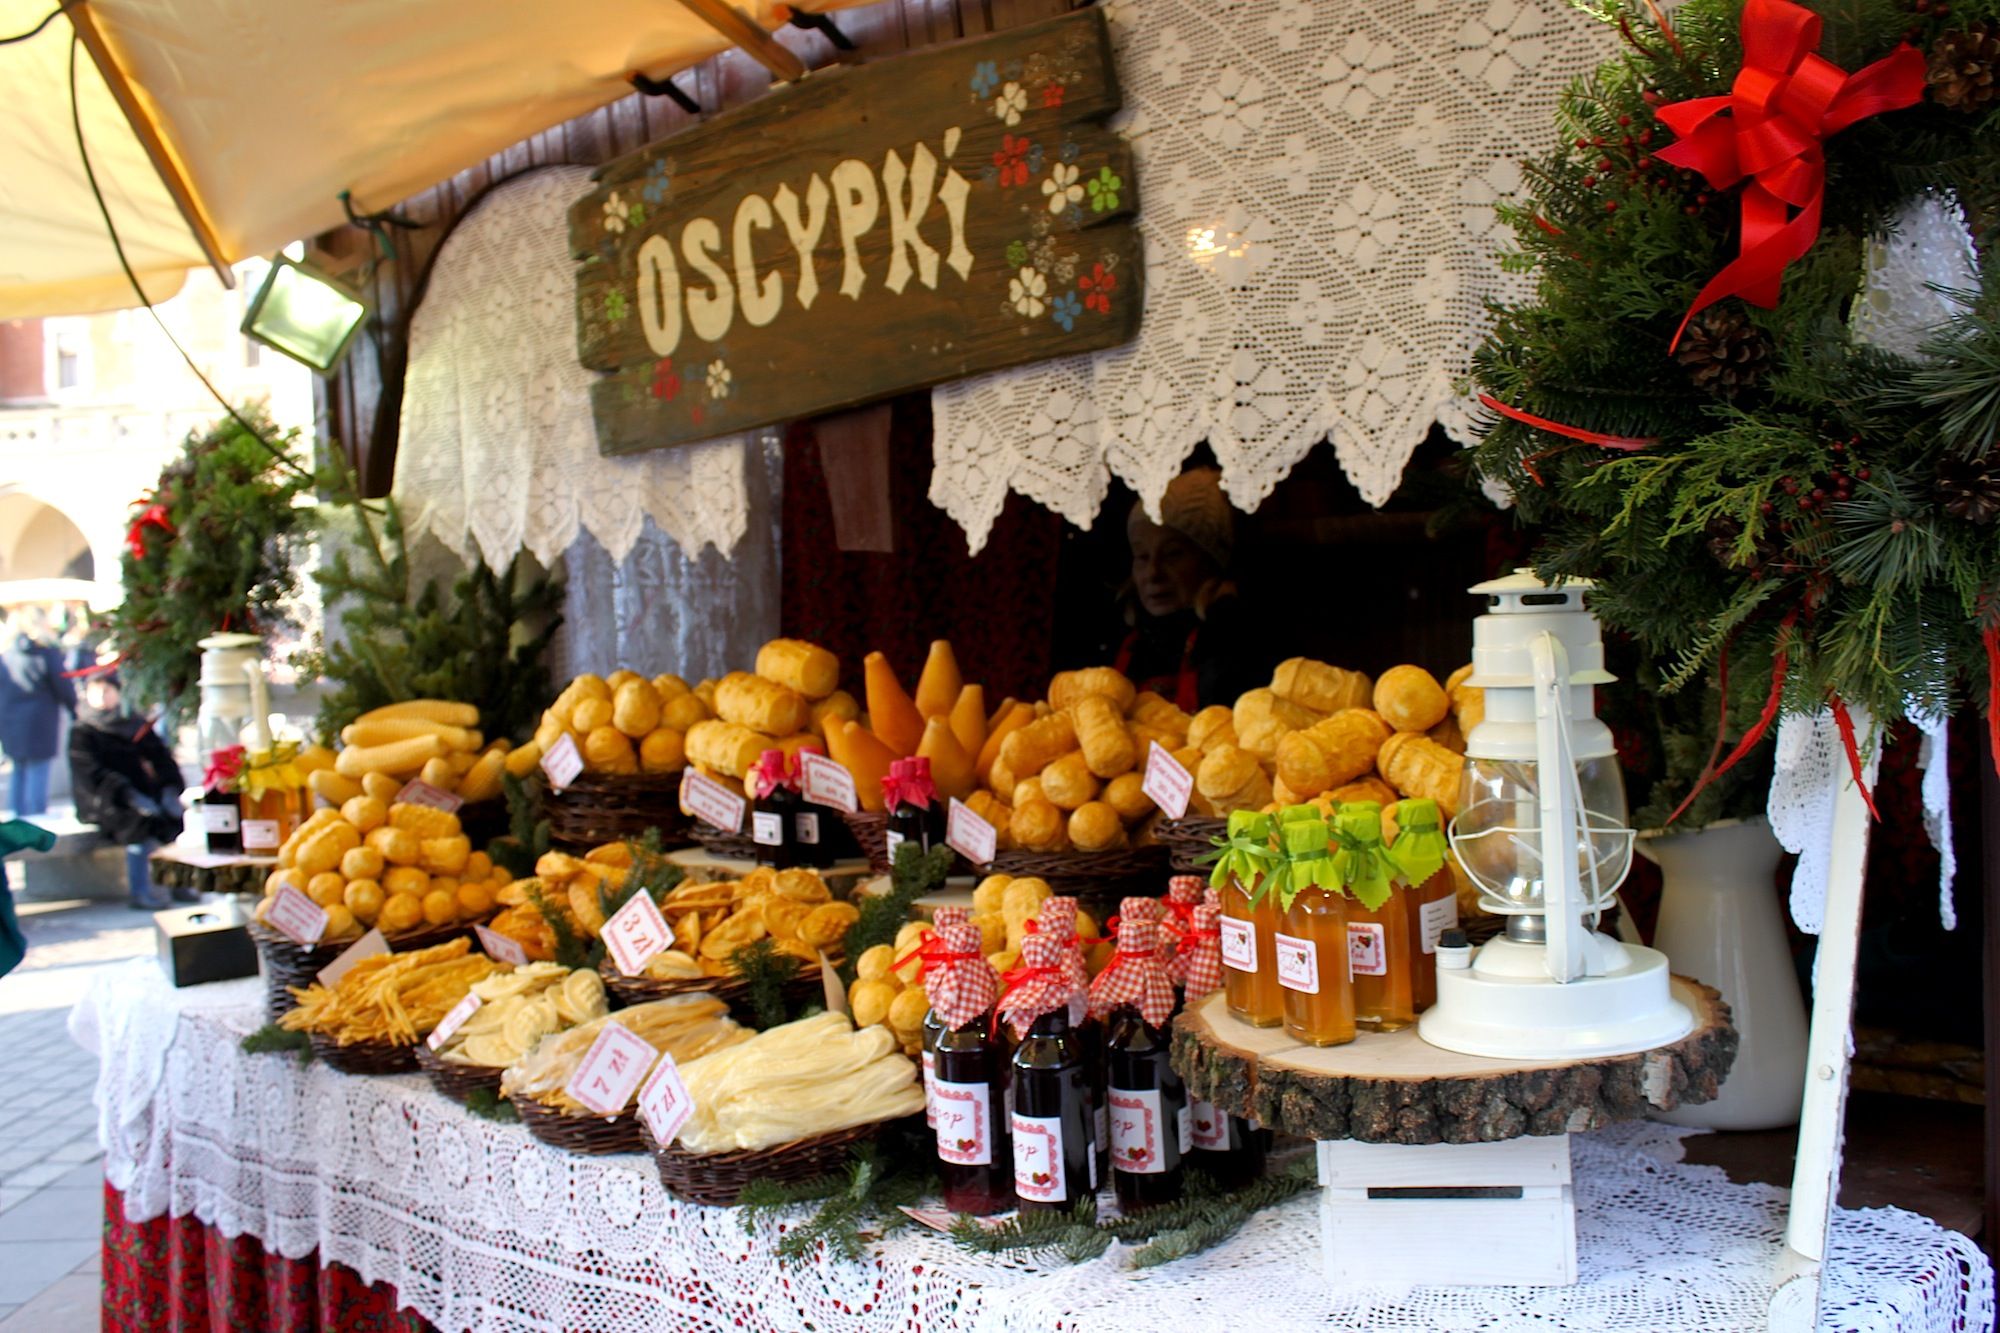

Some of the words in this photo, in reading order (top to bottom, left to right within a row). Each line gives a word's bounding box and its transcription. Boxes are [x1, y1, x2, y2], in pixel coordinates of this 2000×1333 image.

[623, 913, 641, 932] 3
[632, 932, 655, 955] zł
[592, 1075, 611, 1095] 7
[608, 1047, 630, 1076] zł
[651, 1103, 662, 1125] 7
[661, 1084, 676, 1113] zł
